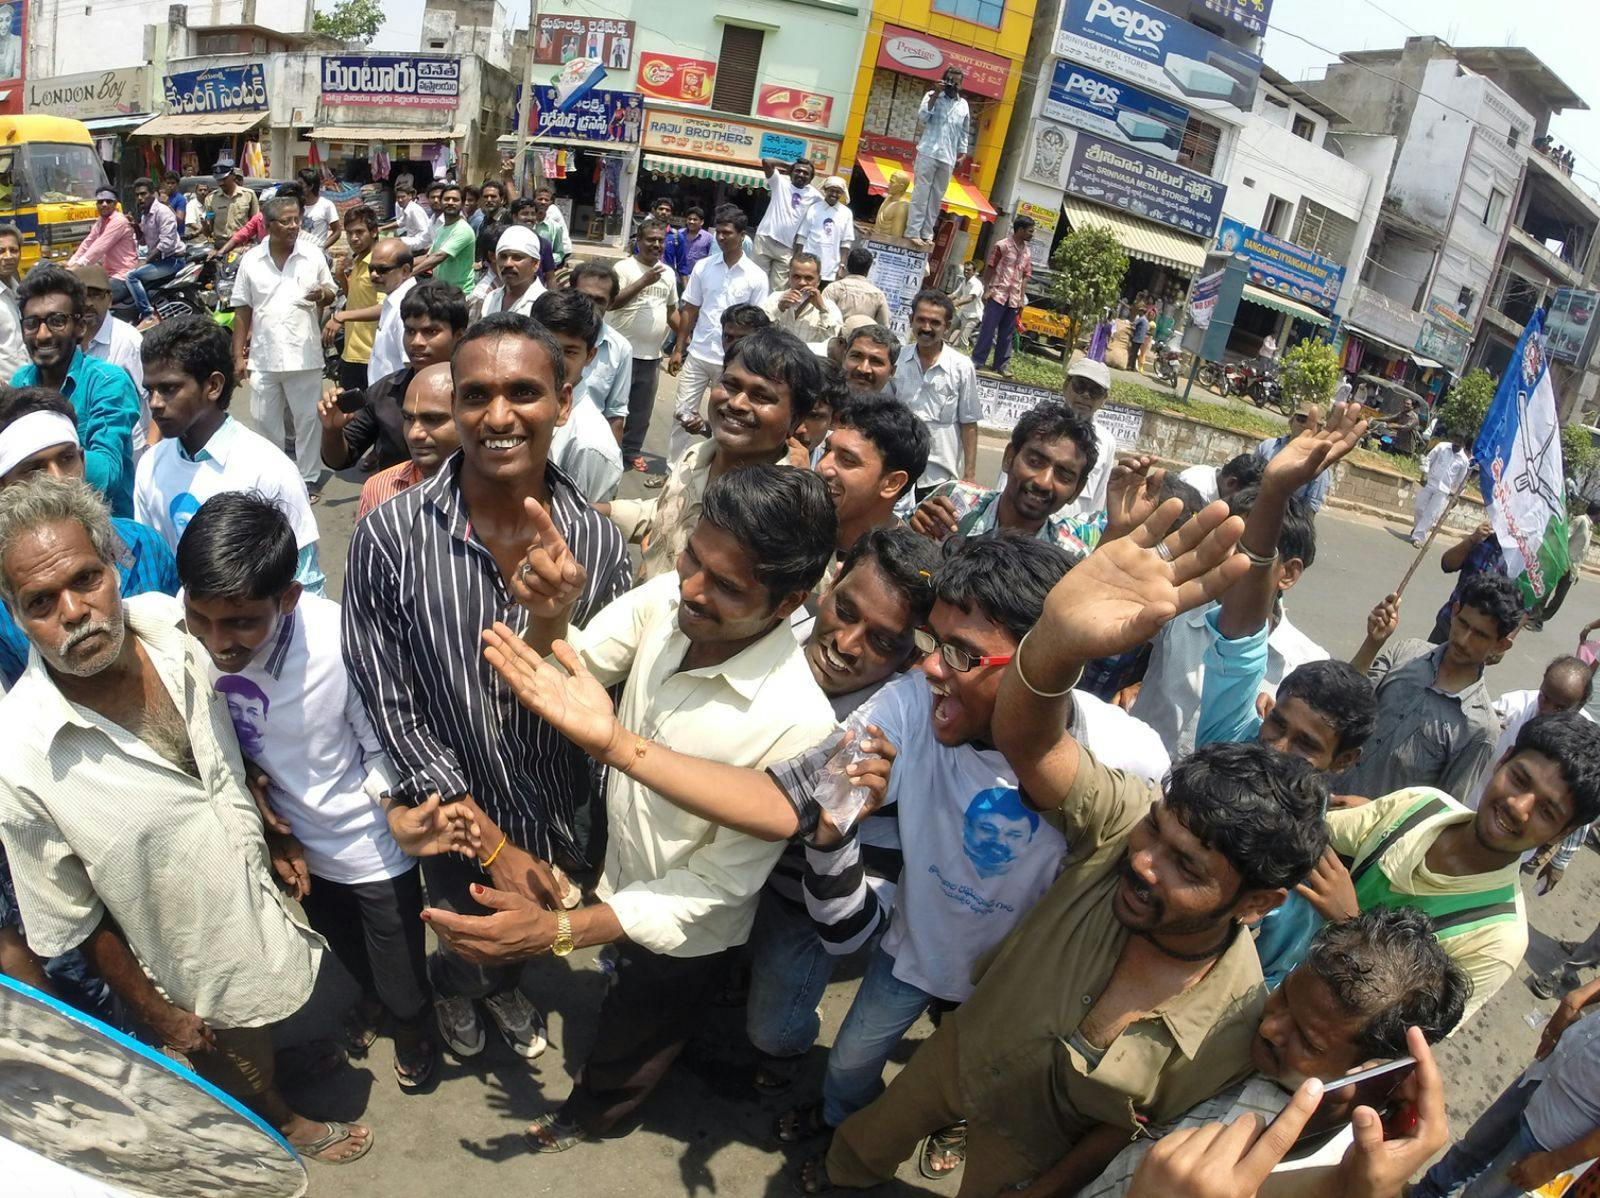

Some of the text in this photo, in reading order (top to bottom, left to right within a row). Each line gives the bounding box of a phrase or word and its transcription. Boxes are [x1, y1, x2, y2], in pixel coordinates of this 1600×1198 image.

[896, 40, 935, 60] Prestige
[1060, 33, 1148, 69] SRINIVASA METAL STORES
[28, 71, 127, 107] LONDON Boy
[1063, 72, 1121, 103] peps
[650, 121, 682, 134] RAJU
[684, 127, 754, 146] BROTHERS
[1096, 166, 1136, 186] SRINIVASA
[1136, 178, 1160, 194] METAL
[1160, 187, 1190, 205] STORES
